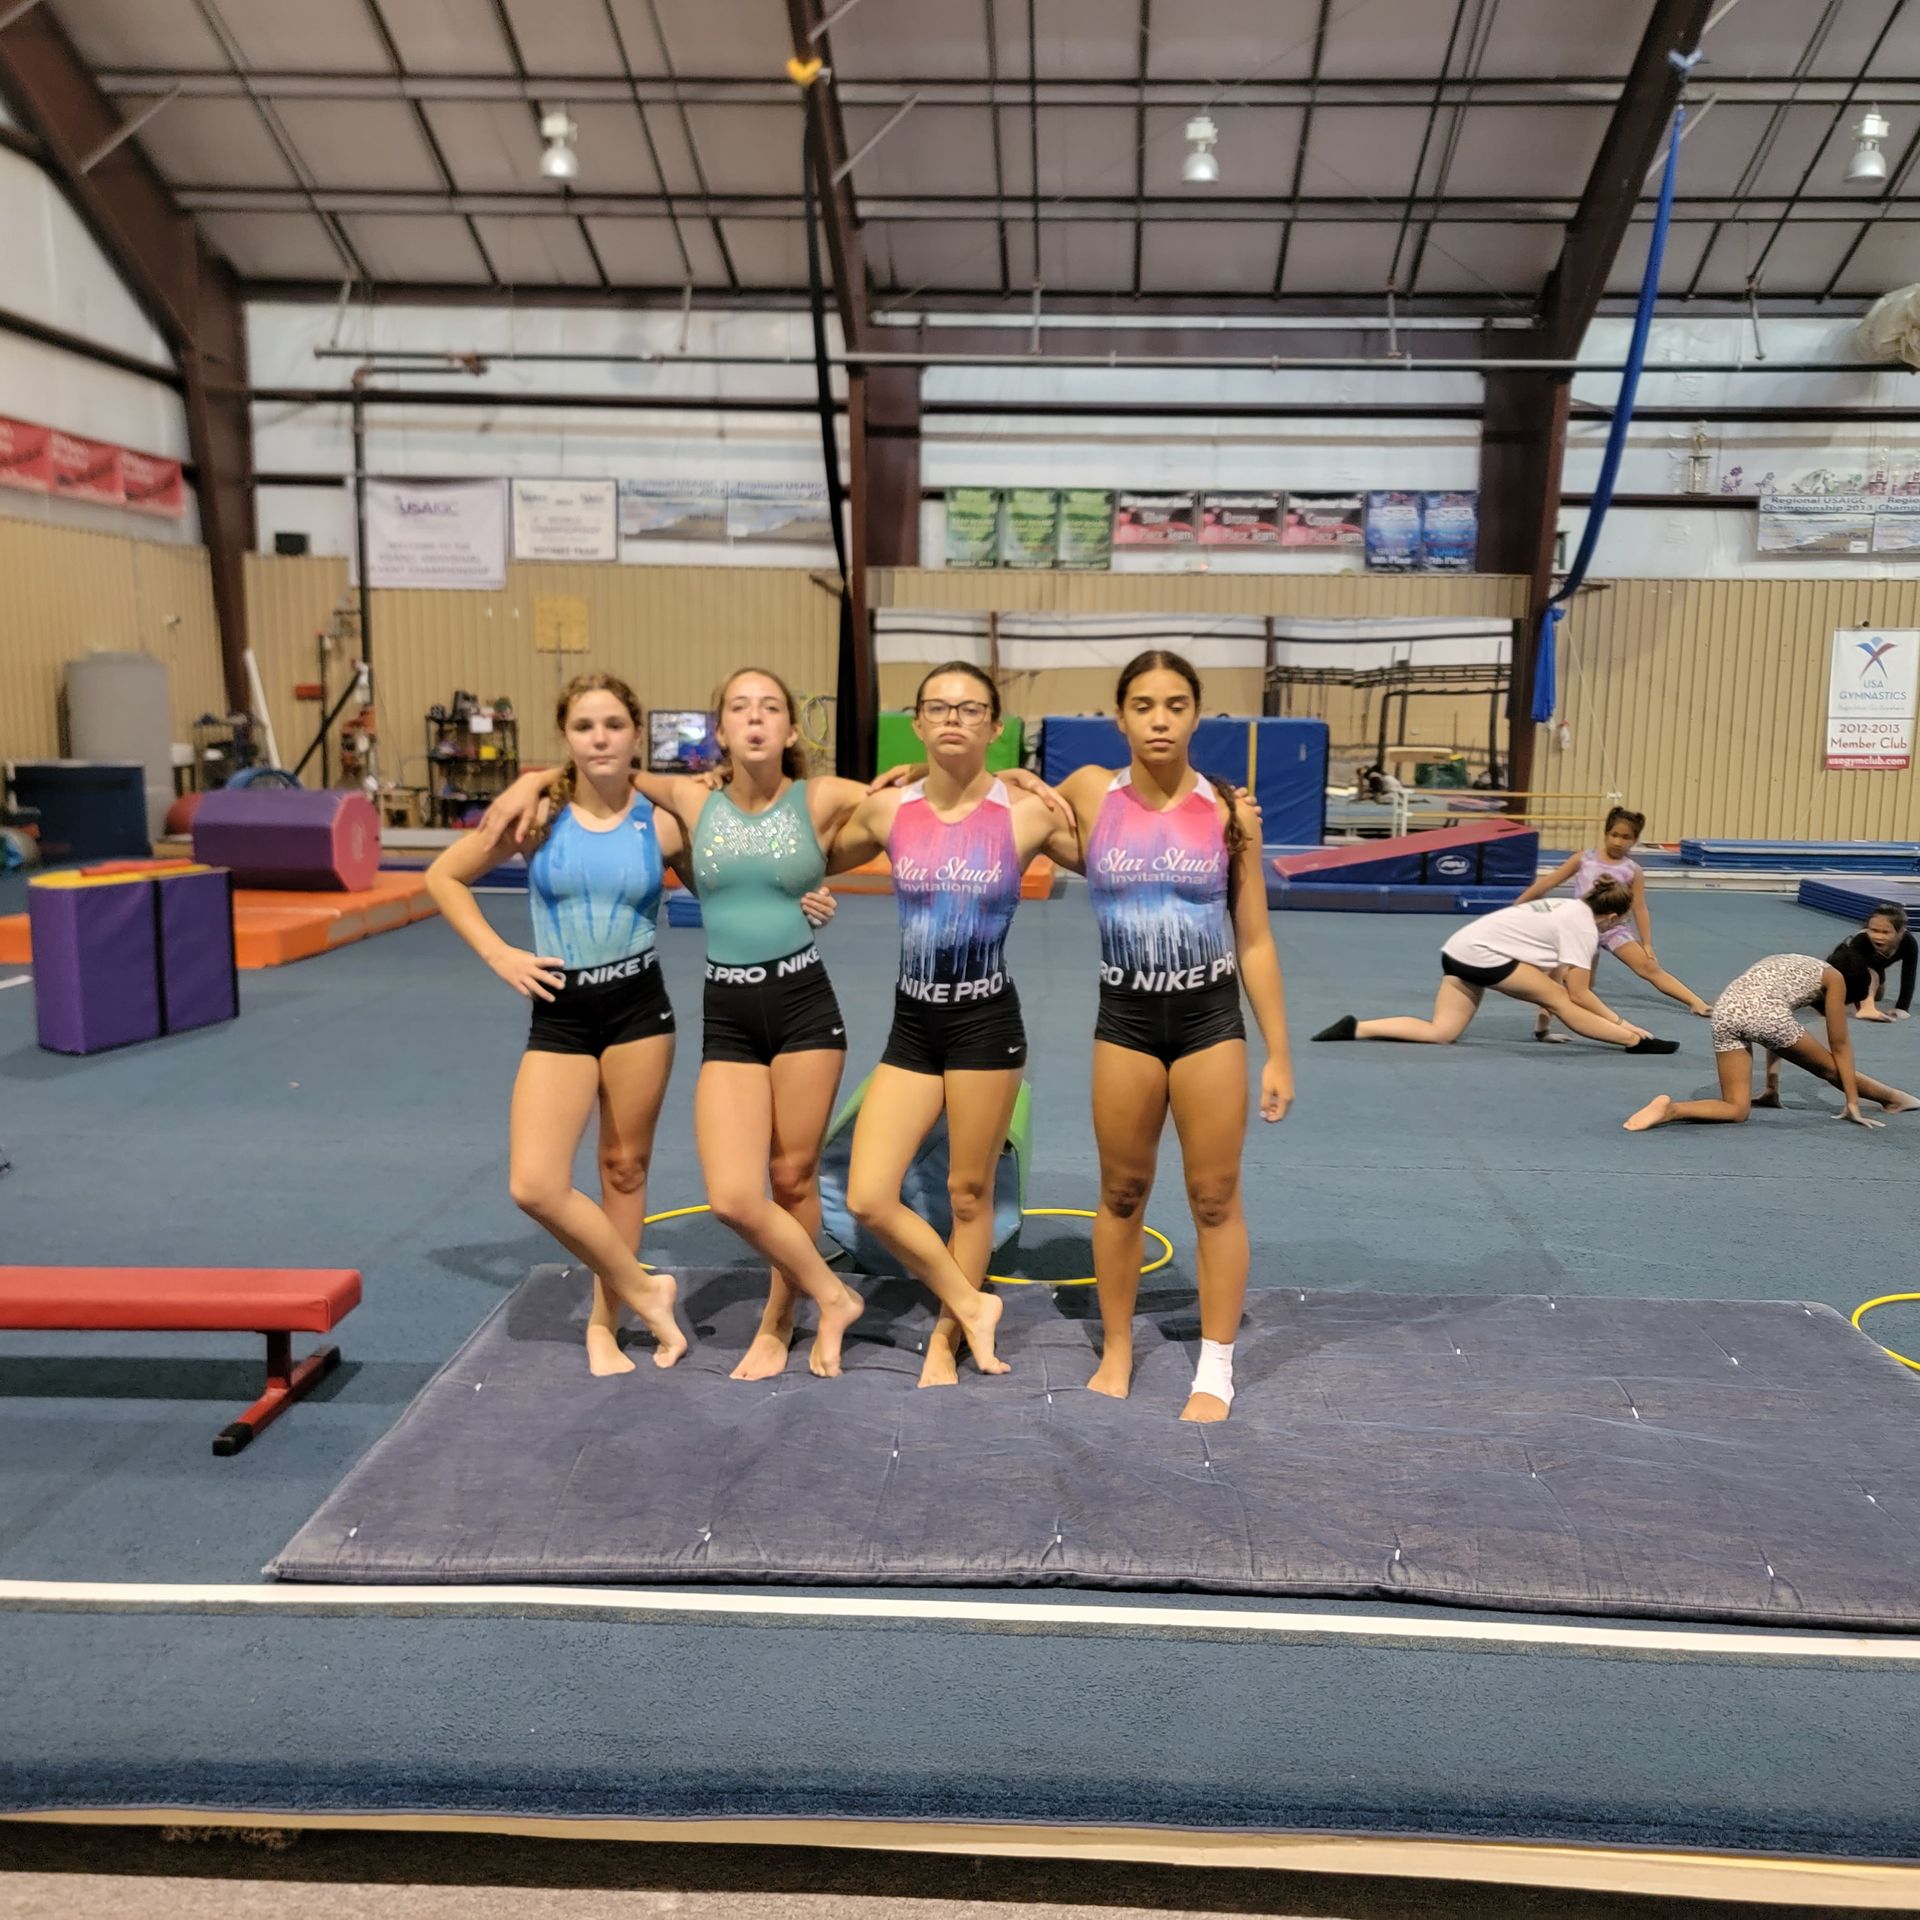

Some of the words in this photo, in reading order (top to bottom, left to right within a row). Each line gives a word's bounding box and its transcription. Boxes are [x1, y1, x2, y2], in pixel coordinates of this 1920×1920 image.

[1823, 495, 1866, 504] USAIGC
[1762, 504, 1844, 512] Championship
[1863, 680, 1884, 688] USA
[1839, 691, 1907, 700] GYMNASTICS
[1839, 723, 1900, 734] 2012-2013
[1830, 737, 1877, 749] Member
[1880, 737, 1908, 749] Club
[1828, 756, 1906, 767] usagymclub.com
[1098, 847, 1144, 873] Star
[1152, 847, 1220, 873] Struck
[894, 856, 928, 881] Star
[936, 856, 1002, 883] Struck
[1111, 871, 1208, 885] Invitational
[901, 881, 987, 895] Invitational
[577, 957, 641, 986] NIKE
[714, 966, 767, 984] PRO
[777, 945, 820, 978] NIKE
[1131, 964, 1206, 992] NIKE
[901, 973, 951, 1003] NIKE
[954, 971, 1003, 1003] PRO
